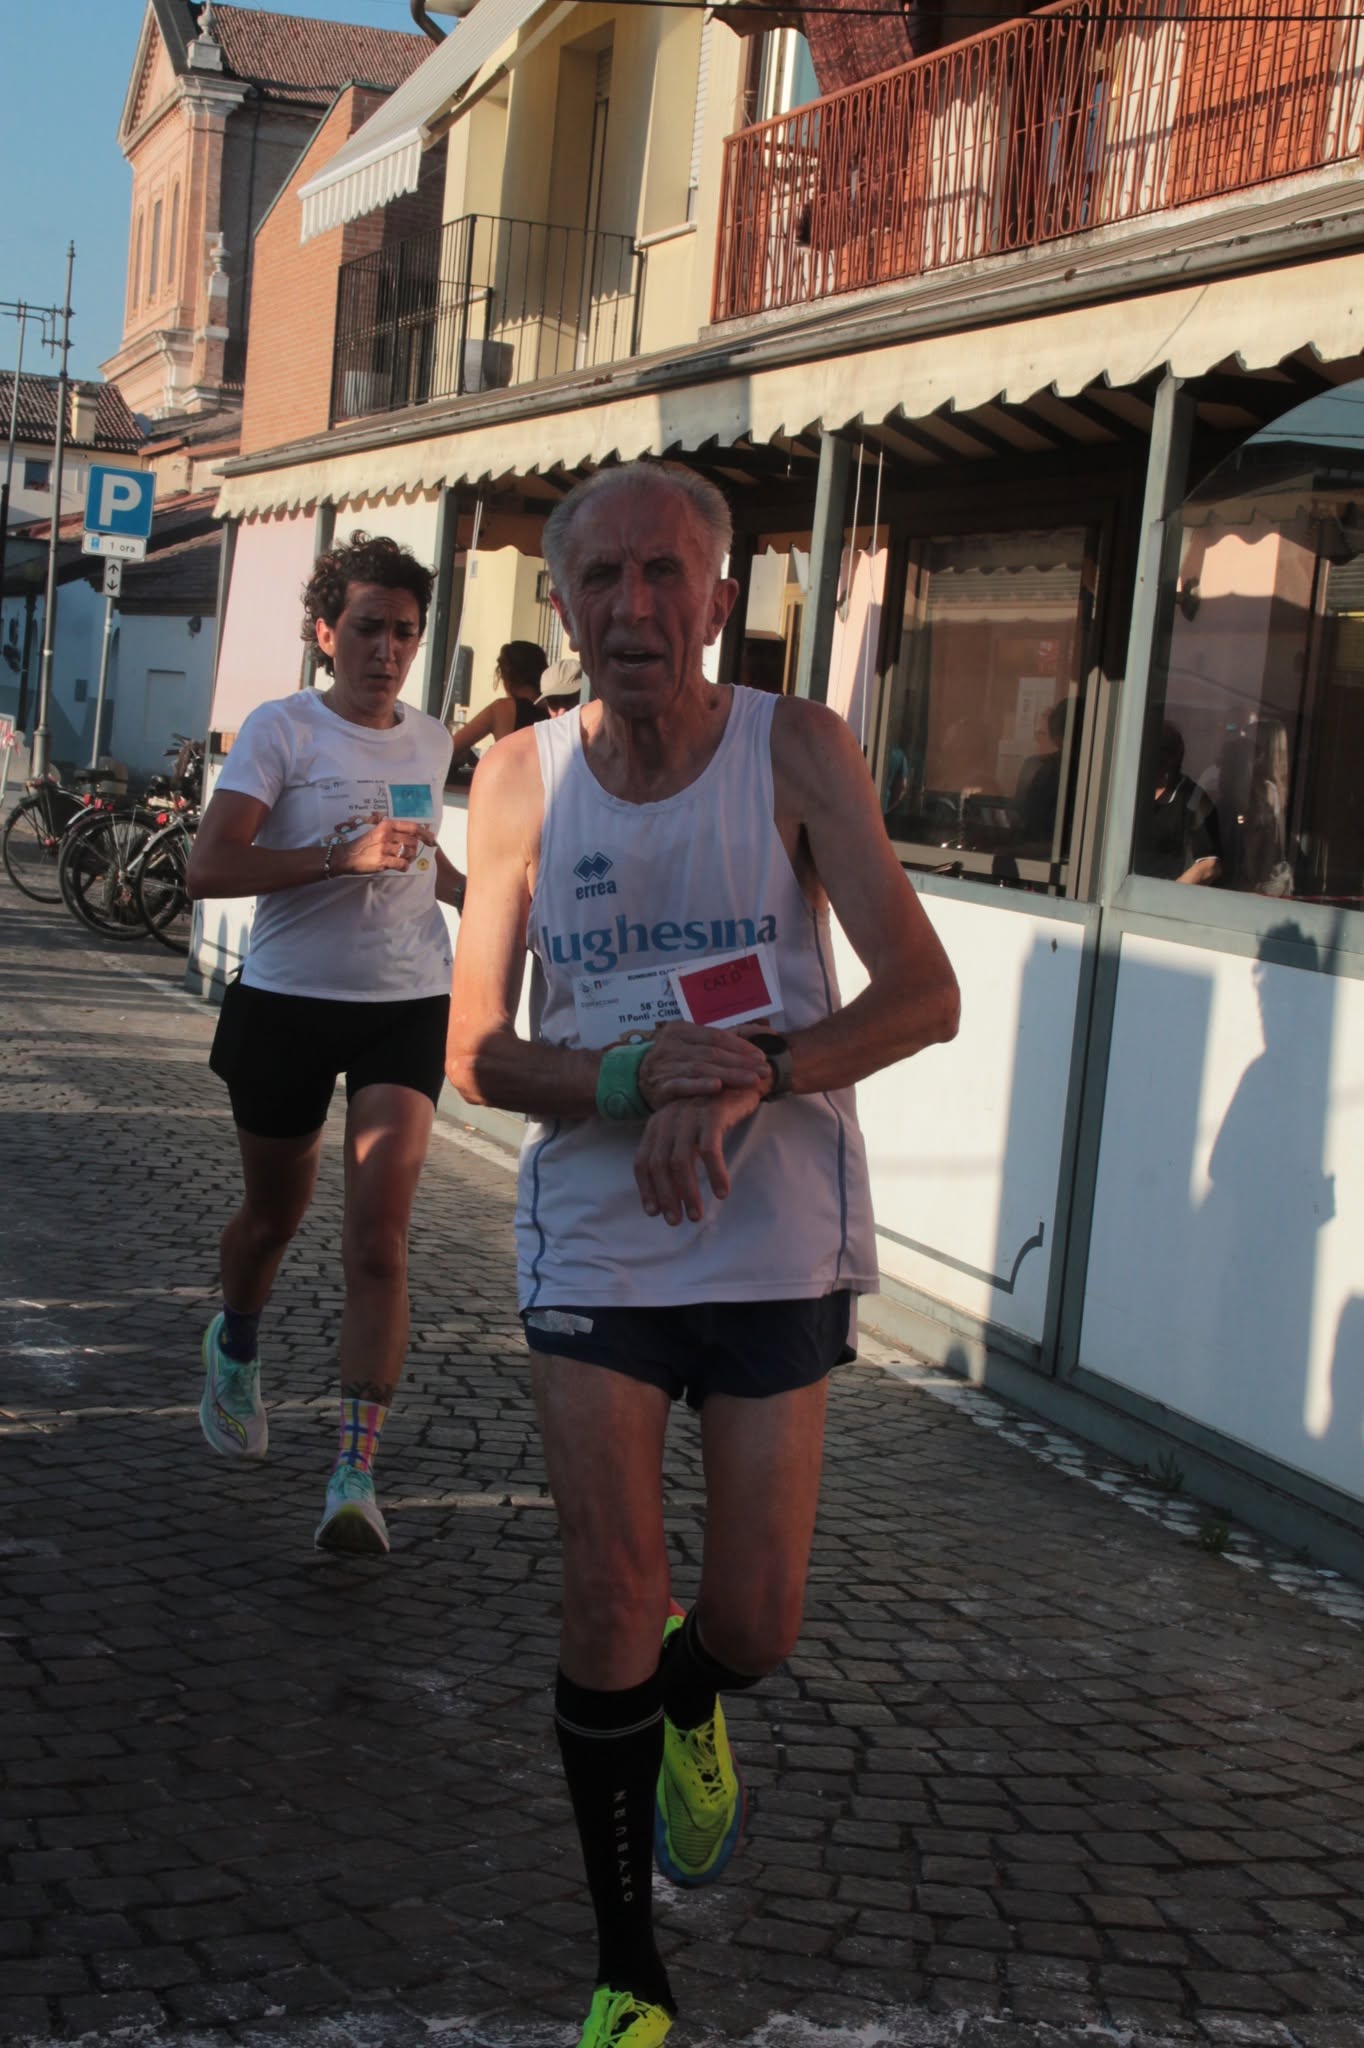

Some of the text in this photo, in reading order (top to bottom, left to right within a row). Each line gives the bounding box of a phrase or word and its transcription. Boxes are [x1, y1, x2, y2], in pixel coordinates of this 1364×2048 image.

[98, 473, 142, 526] P
[119, 544, 136, 553] ora
[575, 878, 617, 900] errea
[542, 913, 777, 974] lughesina
[627, 1011, 650, 1023] Ponti
